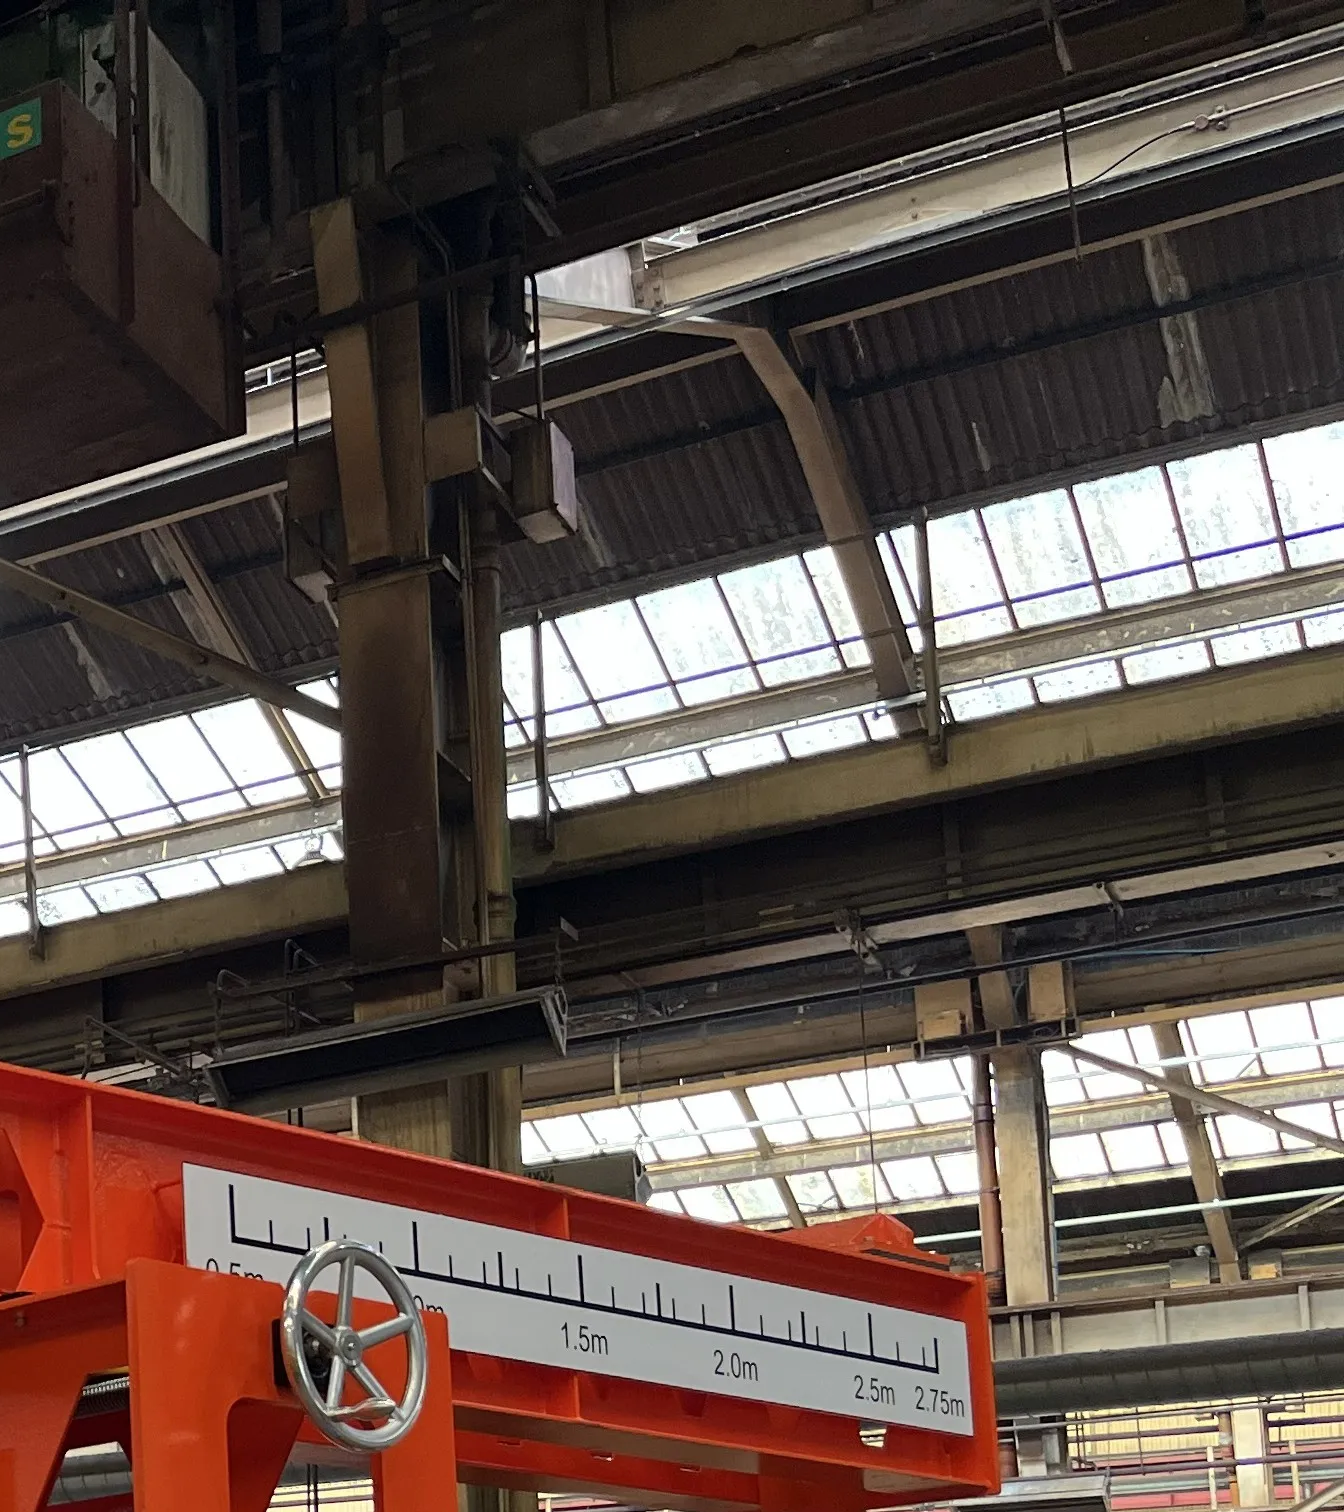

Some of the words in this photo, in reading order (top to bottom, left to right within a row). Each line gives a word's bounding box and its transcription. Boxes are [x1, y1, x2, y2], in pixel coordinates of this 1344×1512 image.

[6, 114, 34, 149] S
[560, 1321, 609, 1356] 1.5m
[713, 1349, 760, 1382] 2.0m
[854, 1375, 896, 1406] 2.5m
[914, 1385, 966, 1418] 2.75m
